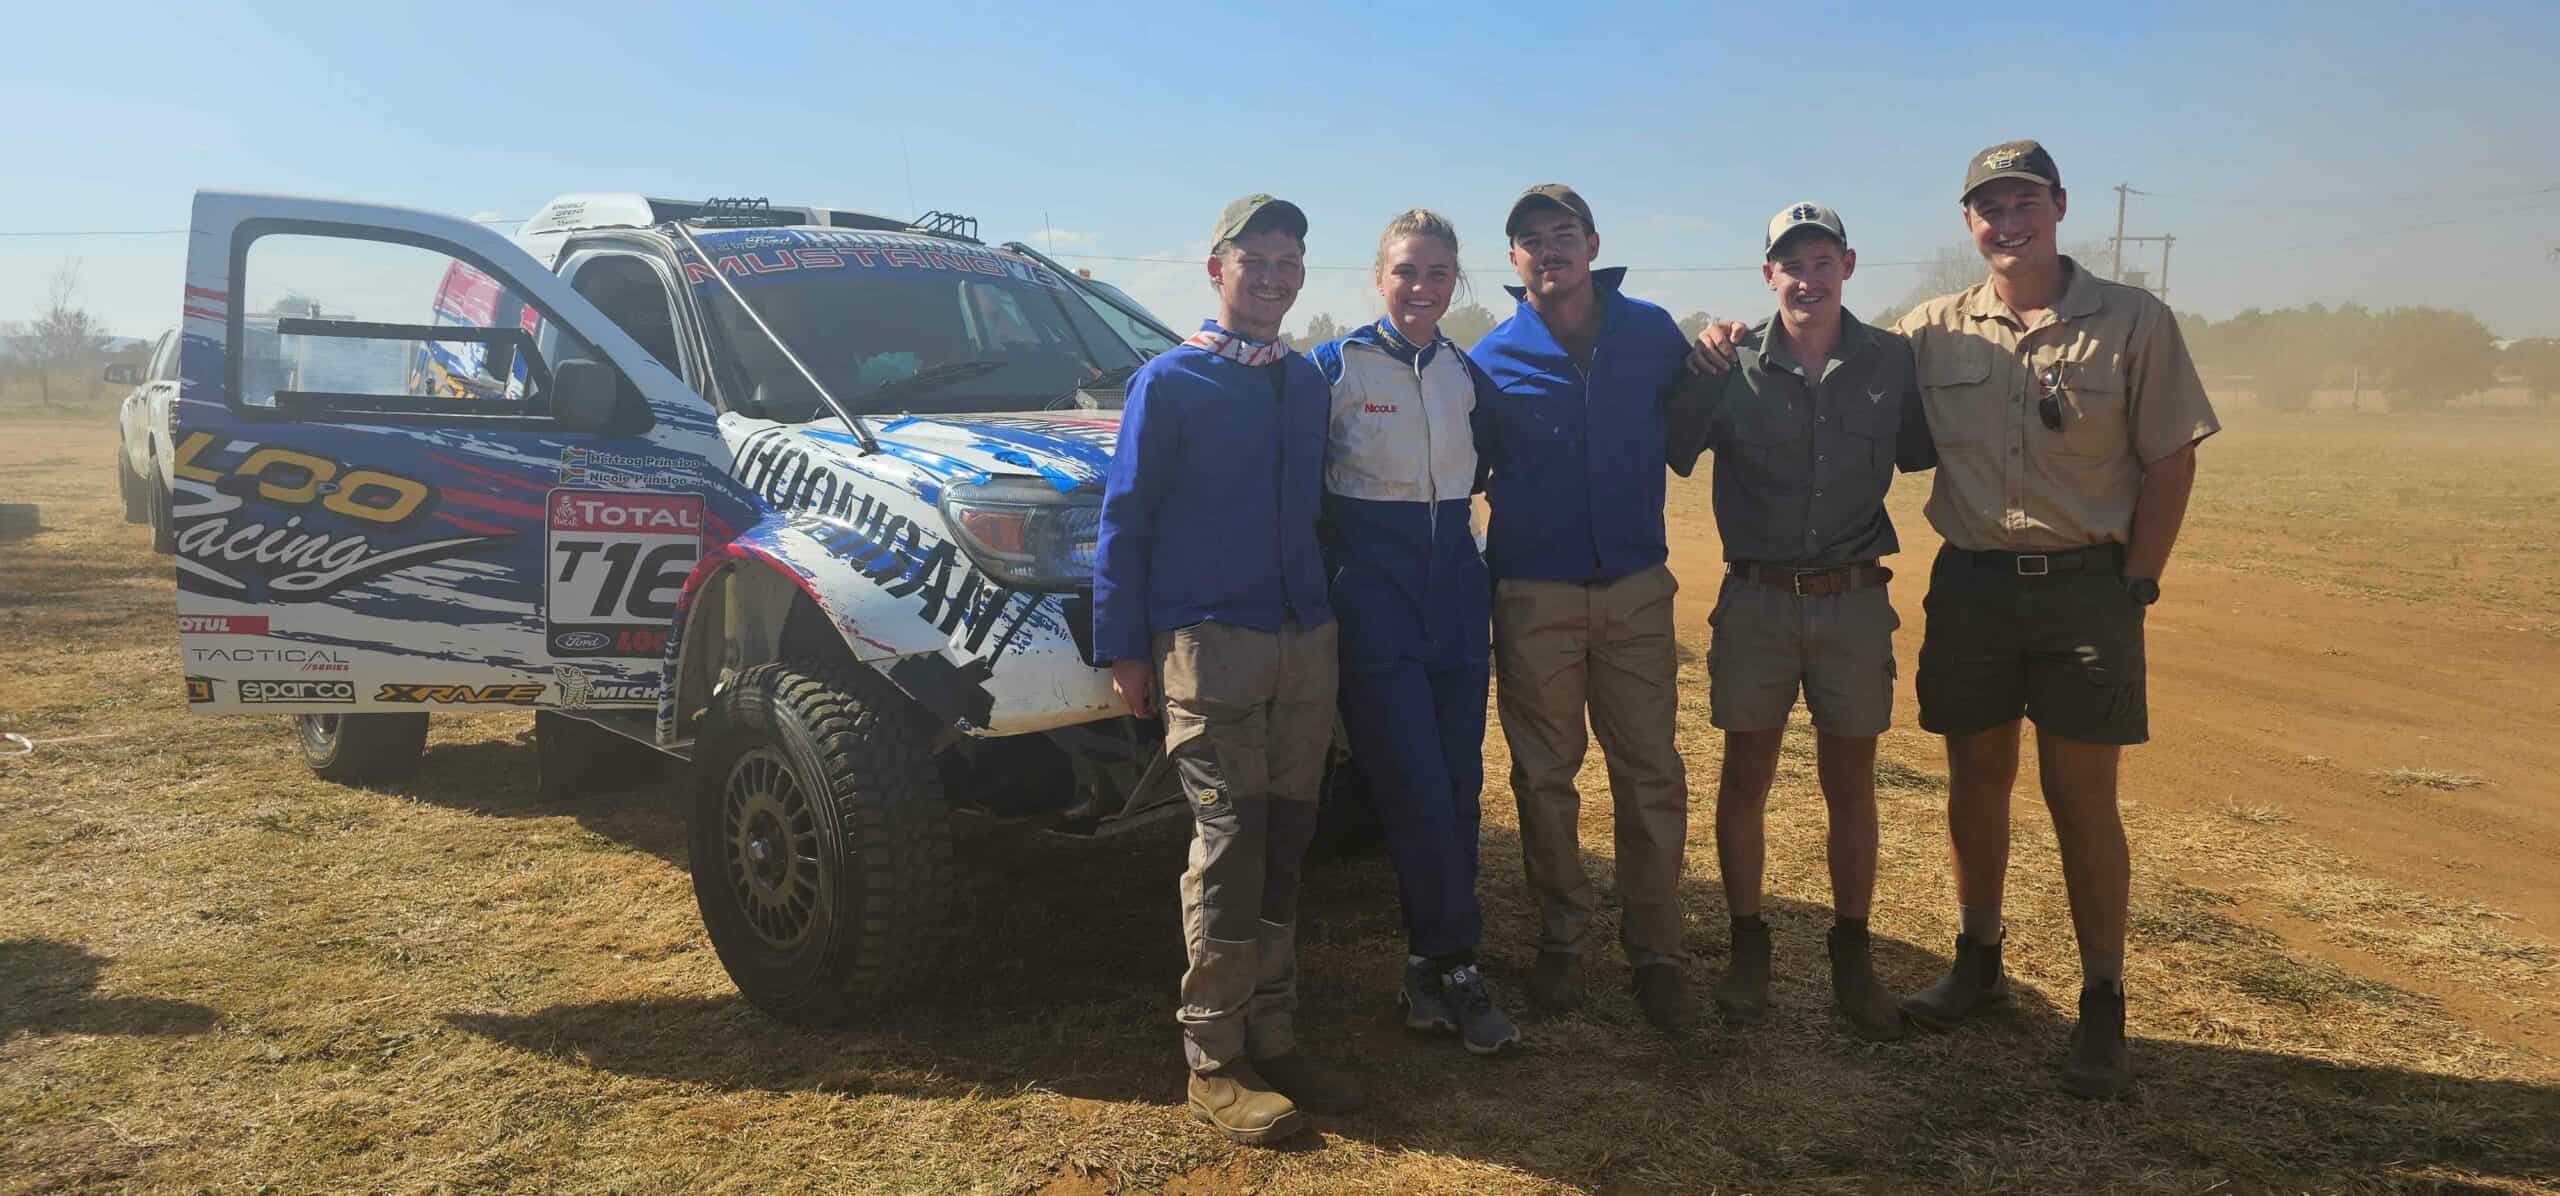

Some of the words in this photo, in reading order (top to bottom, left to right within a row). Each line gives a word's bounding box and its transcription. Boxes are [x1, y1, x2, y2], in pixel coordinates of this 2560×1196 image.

[684, 247, 1008, 285] MUSTANG
[590, 453, 642, 468] Hertzog
[646, 456, 699, 470] Prinsloo
[589, 470, 631, 483] Nicole
[635, 474, 688, 487] Prinsloo
[575, 500, 699, 529] TOTAL
[177, 617, 230, 632] OTUL
[564, 633, 600, 648] Ford
[191, 648, 350, 664] TACTICAL
[241, 681, 353, 701] sparco
